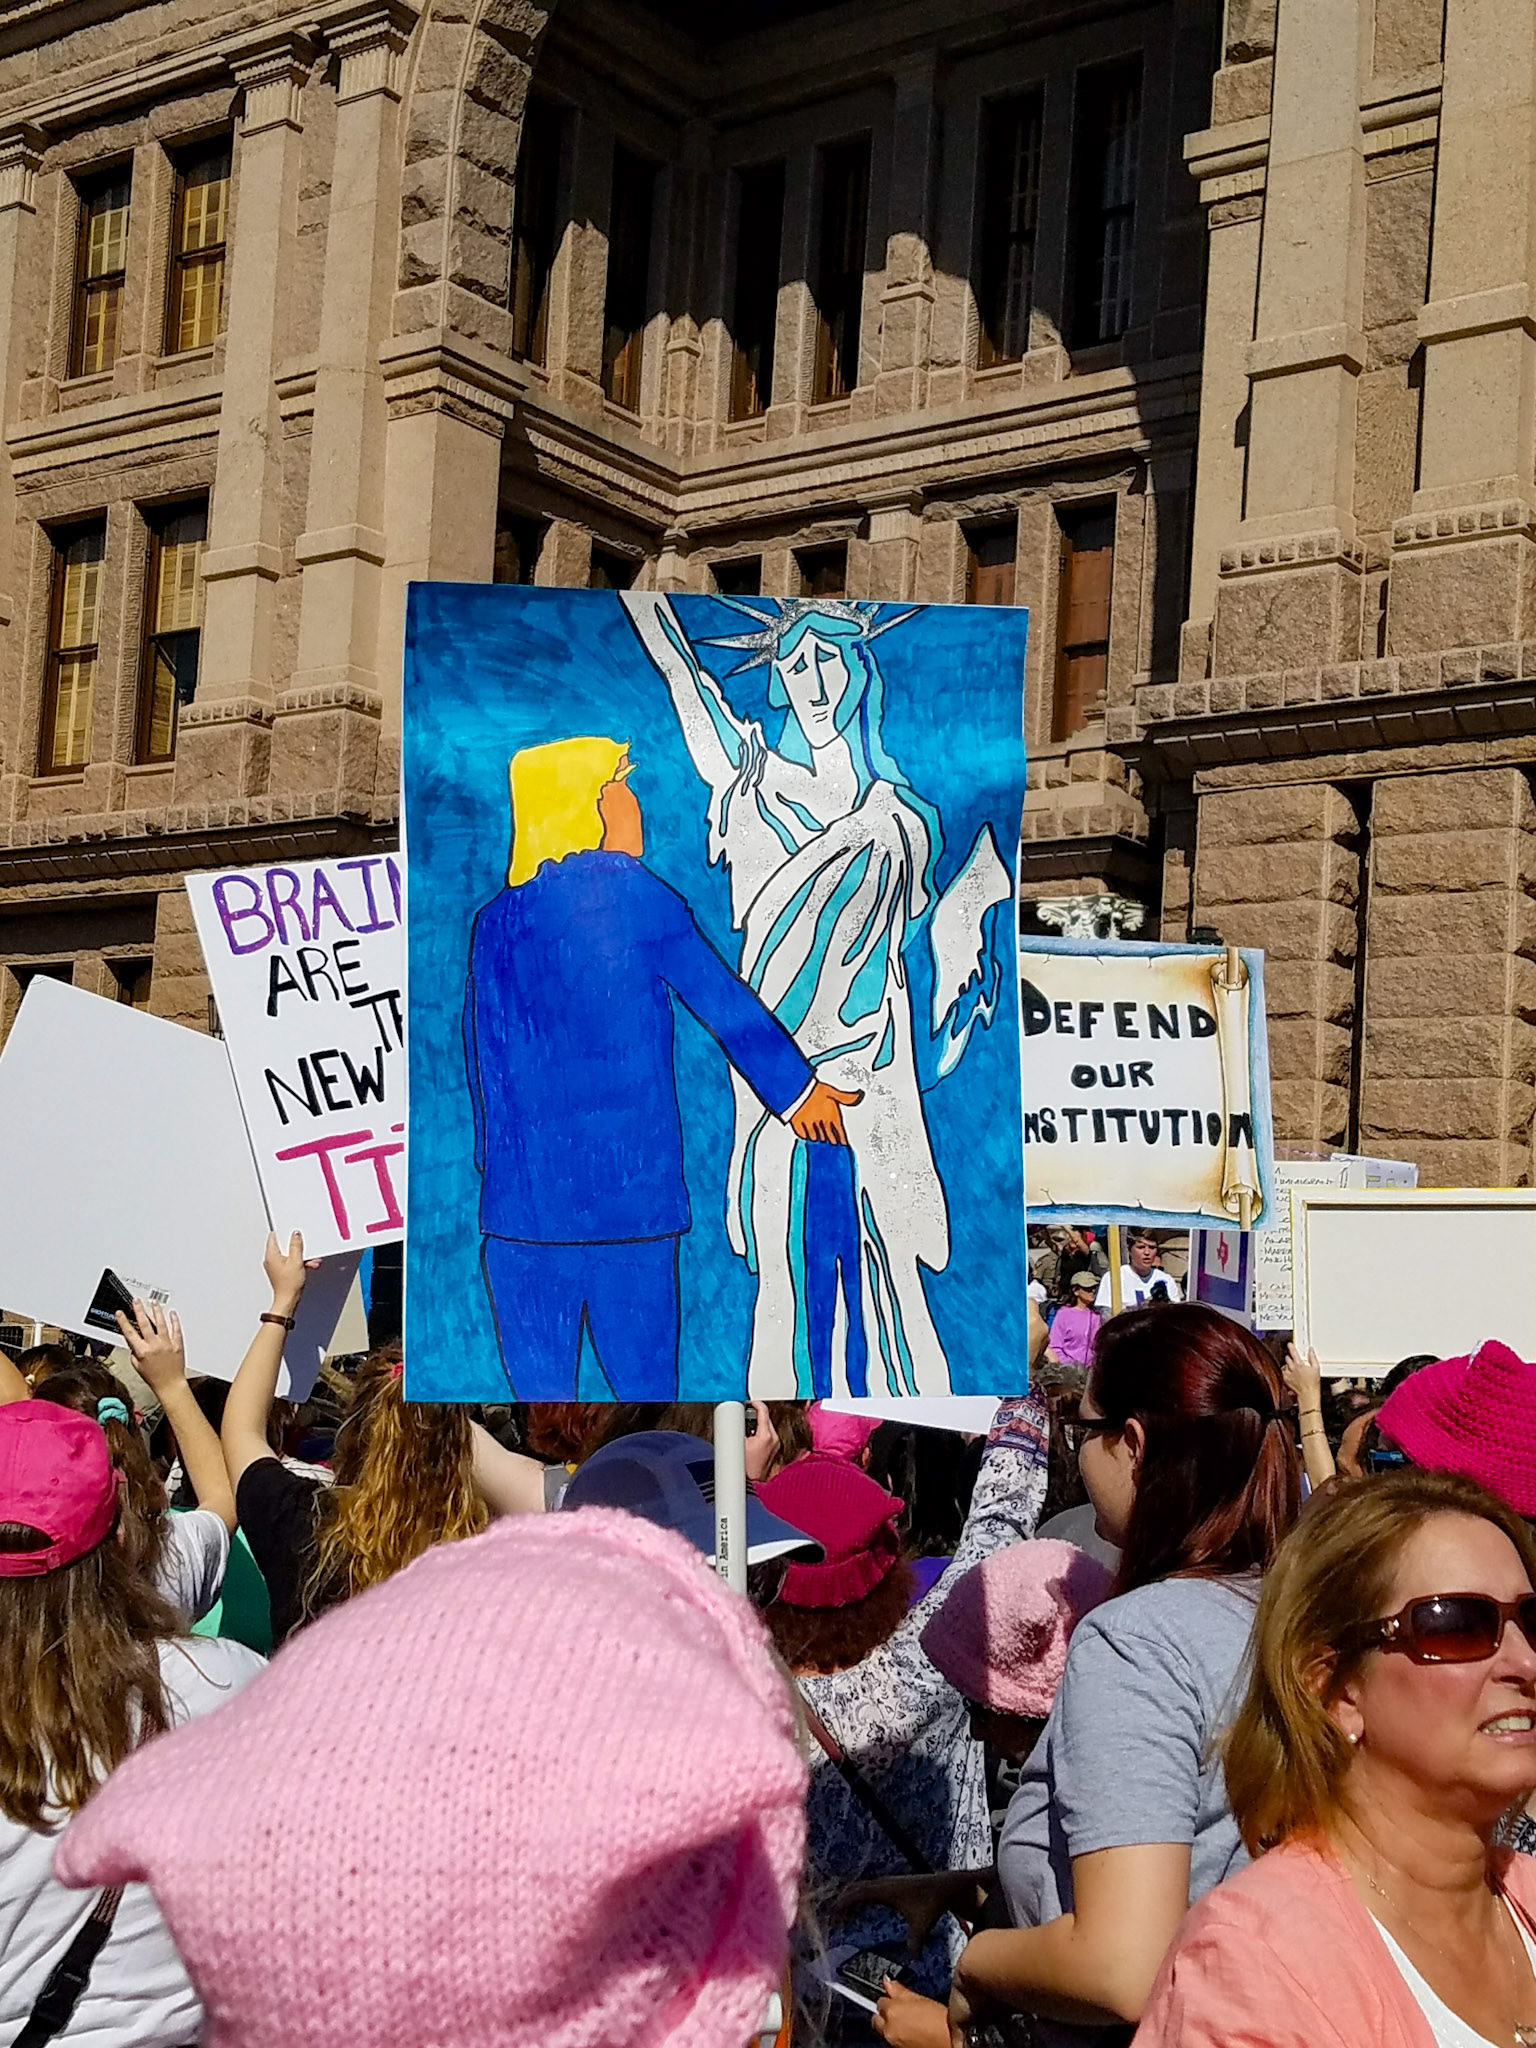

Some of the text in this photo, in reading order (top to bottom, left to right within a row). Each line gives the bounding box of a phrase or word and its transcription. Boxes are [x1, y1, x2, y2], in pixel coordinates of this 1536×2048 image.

[266, 939, 370, 1018] ARE
[1020, 977, 1217, 1040] DEFEND
[264, 1046, 385, 1126] NEW
[1070, 1060, 1156, 1090] OUR
[275, 1122, 405, 1241] TI
[719, 1517, 729, 1561] America
